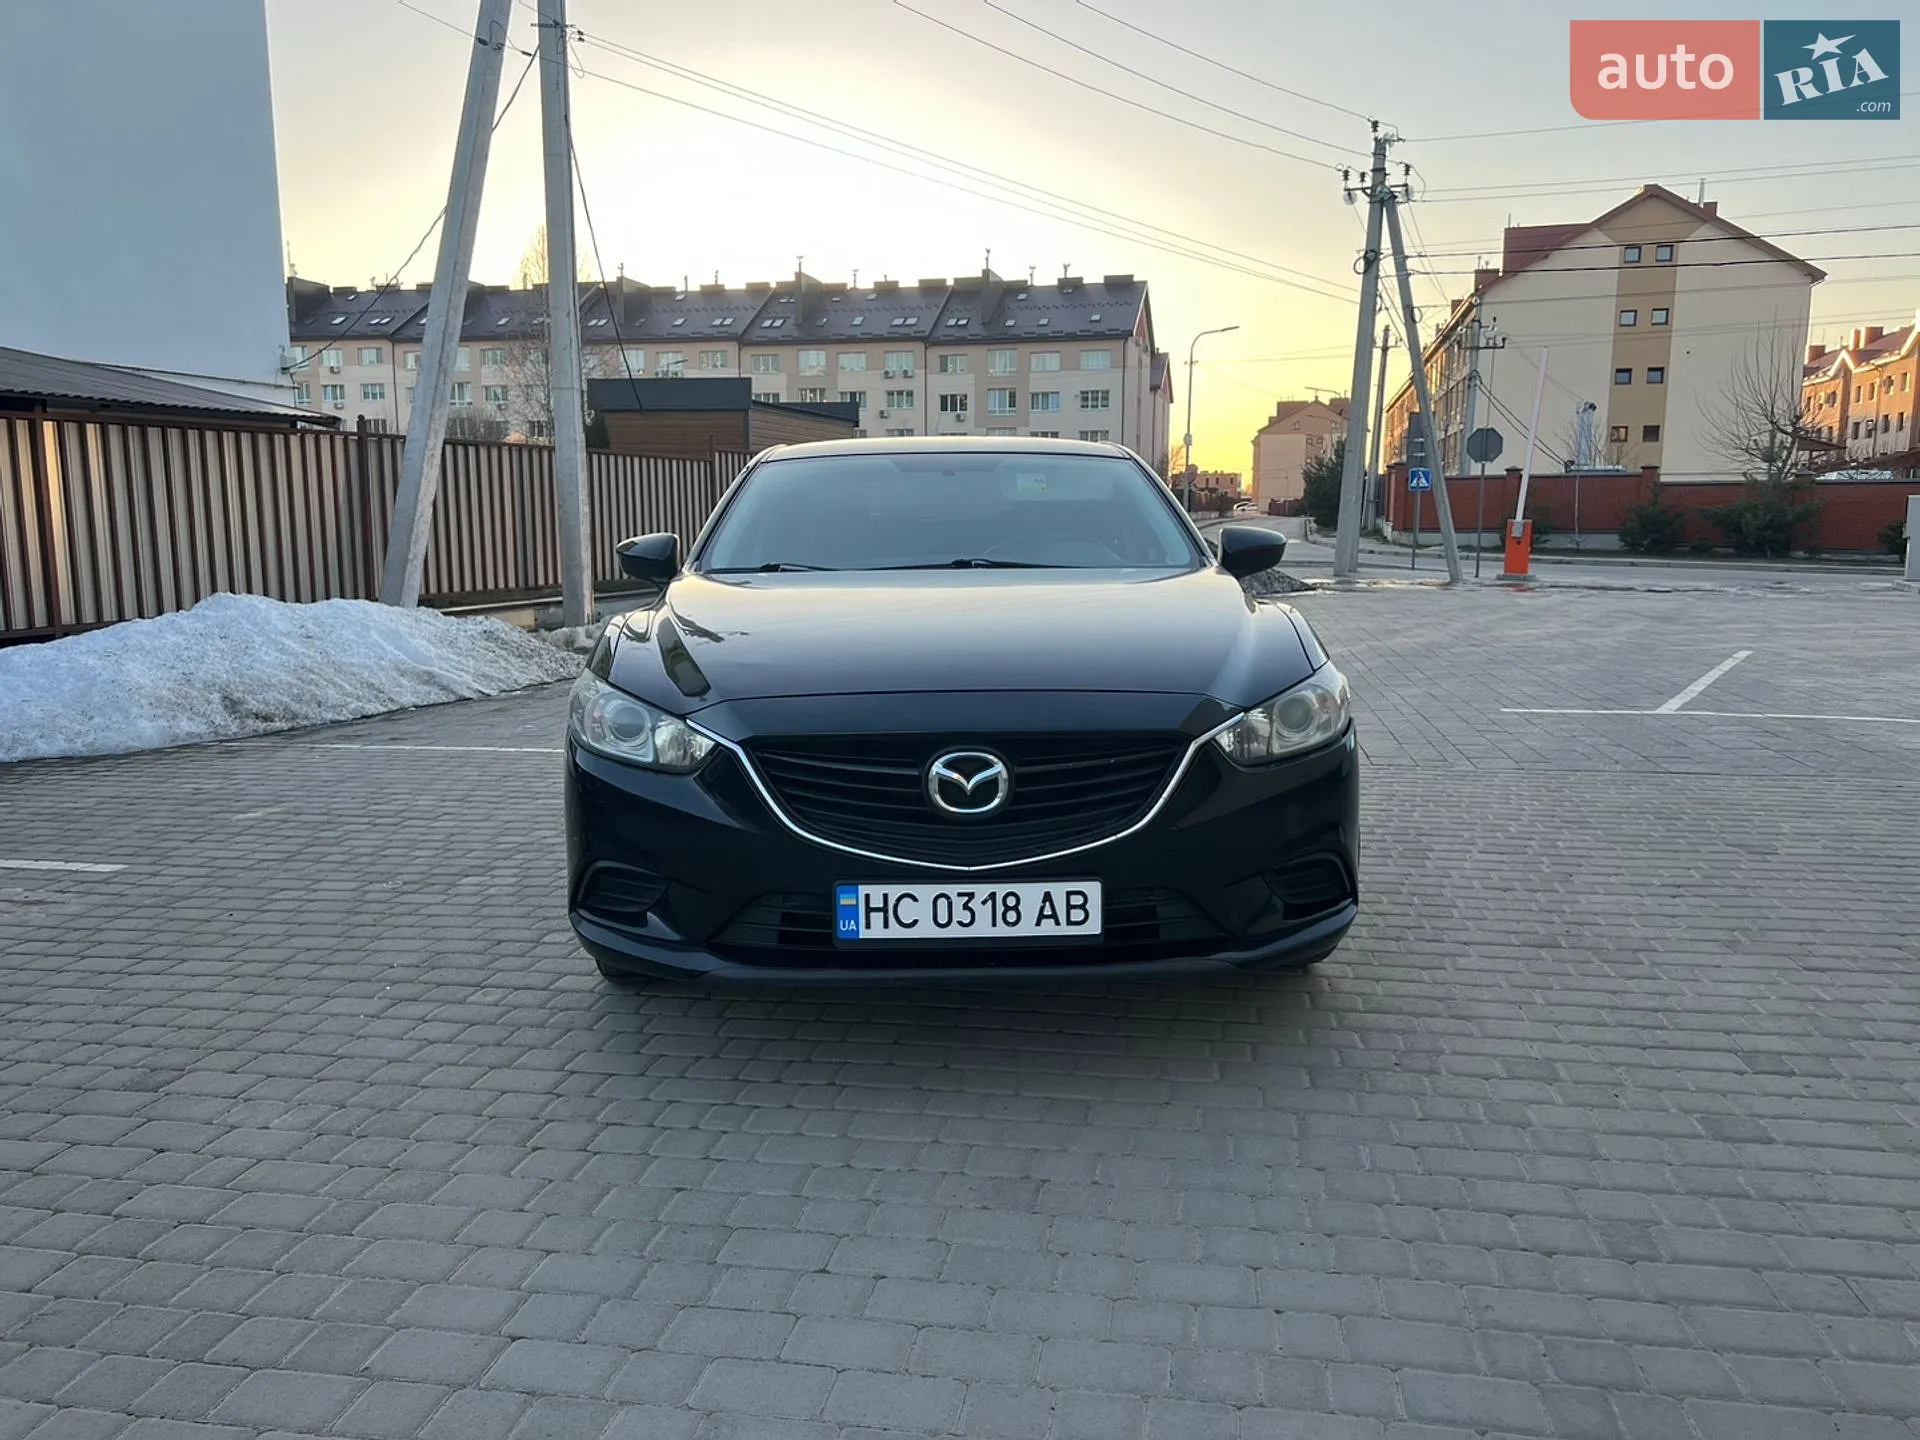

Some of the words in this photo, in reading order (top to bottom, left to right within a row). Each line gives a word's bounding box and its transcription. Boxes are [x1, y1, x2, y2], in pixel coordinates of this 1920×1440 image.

[864, 892, 919, 930] HC
[931, 890, 1022, 929] 0318
[1034, 889, 1090, 928] AB
[839, 919, 857, 932] UA
